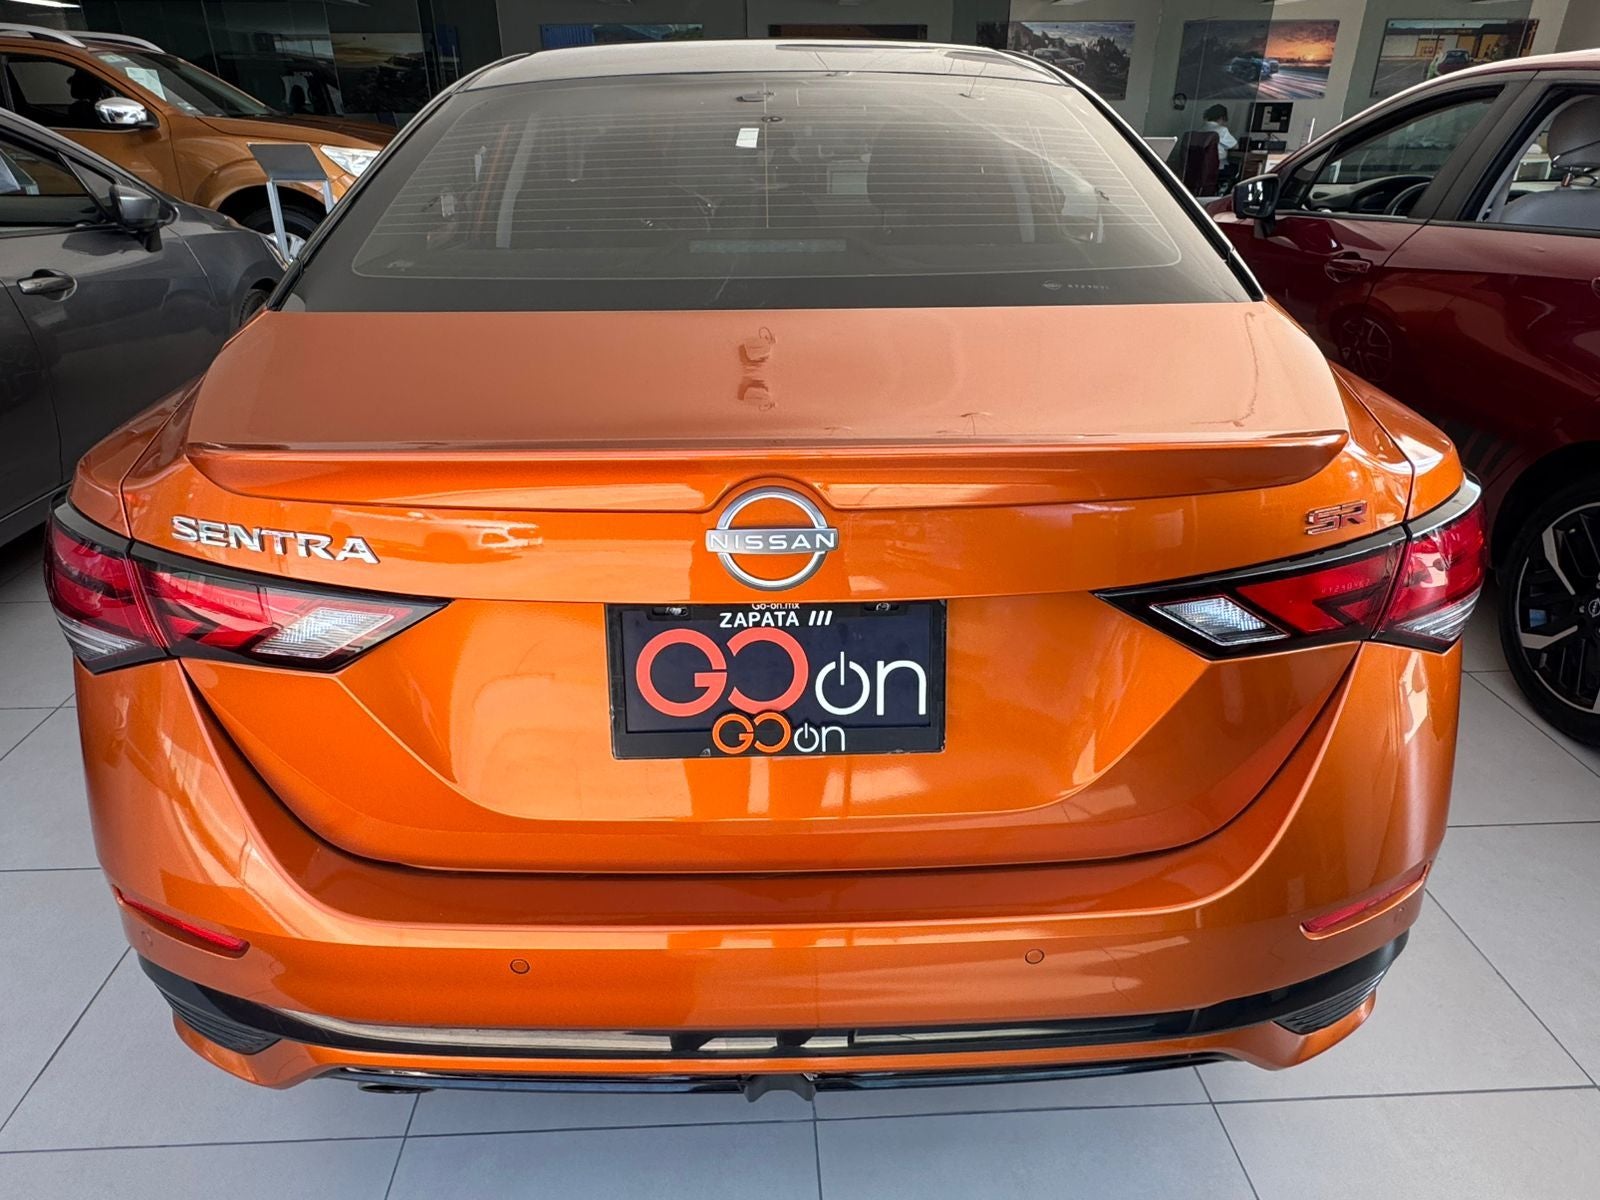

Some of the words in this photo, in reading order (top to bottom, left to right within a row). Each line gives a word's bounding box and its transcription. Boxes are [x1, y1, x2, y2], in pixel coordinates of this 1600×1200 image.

[1304, 500, 1368, 535] SR
[171, 514, 381, 565] SENTRA
[709, 532, 835, 550] NISSAN
[719, 610, 800, 628] ZAPATA
